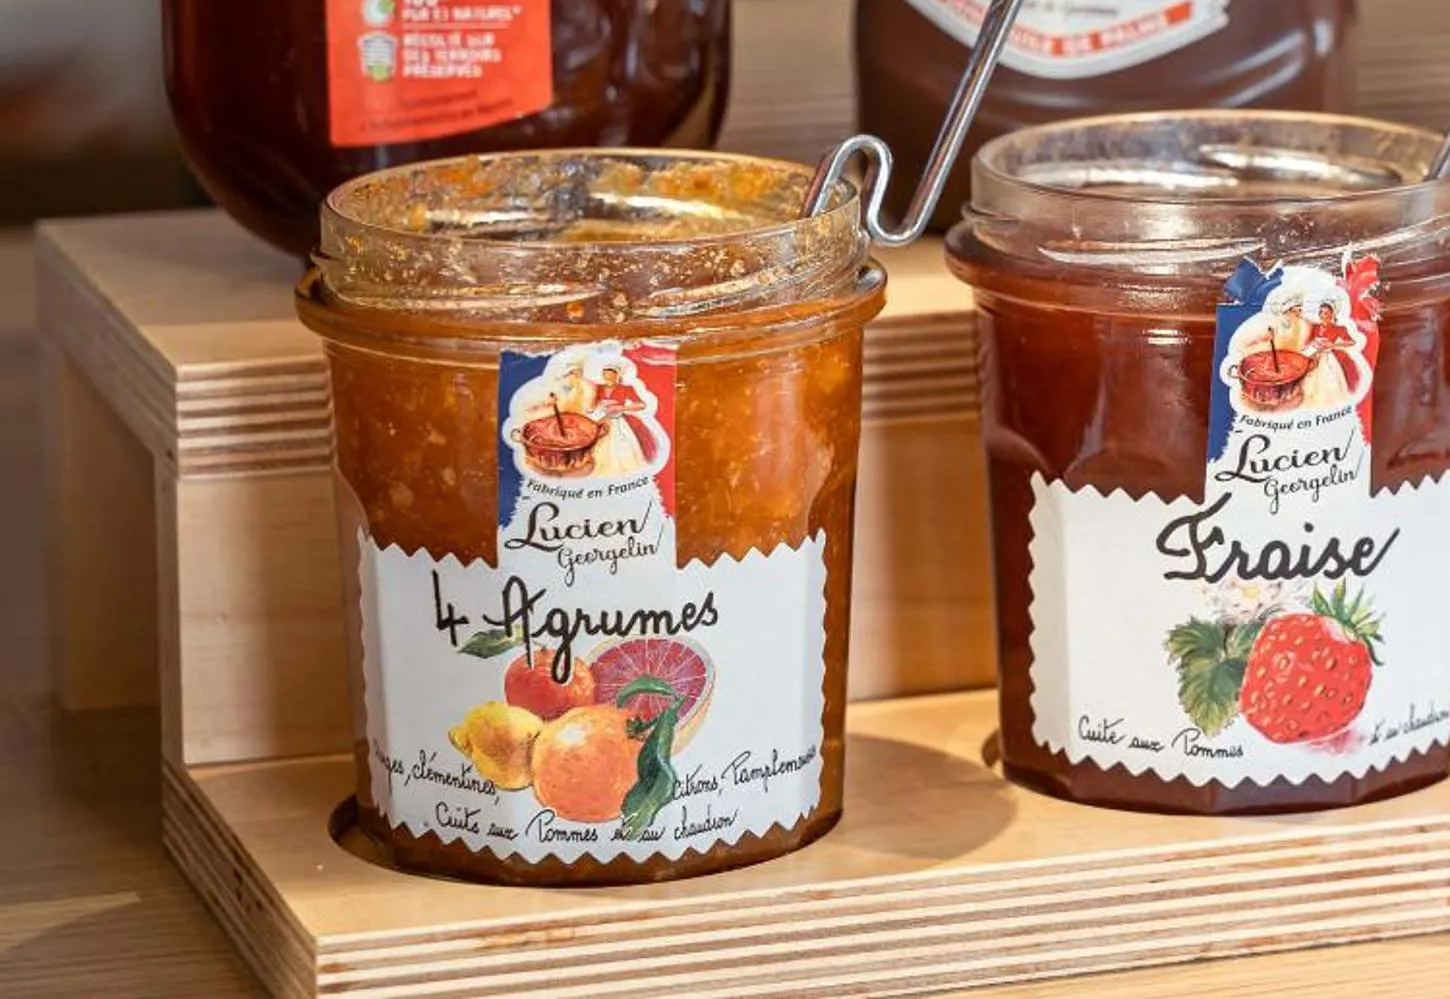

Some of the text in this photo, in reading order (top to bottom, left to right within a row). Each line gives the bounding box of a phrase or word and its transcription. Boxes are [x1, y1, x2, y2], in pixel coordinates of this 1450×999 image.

[1238, 405, 1353, 431] Fabriqué en France
[1214, 427, 1355, 484] Lucien
[1263, 451, 1364, 515] Georgelin
[526, 475, 650, 501] Fabriqué en France
[504, 498, 653, 551] Lucien
[1156, 492, 1400, 583] Fraise
[557, 521, 664, 587] Georgelin
[432, 570, 720, 685] 4 Agrumes
[1128, 736, 1165, 753] aux
[1171, 727, 1244, 758] Pommes
[487, 823, 519, 841] aux
[525, 808, 599, 843] Pommes
[637, 826, 666, 843] au
[674, 804, 740, 840] chaudron
